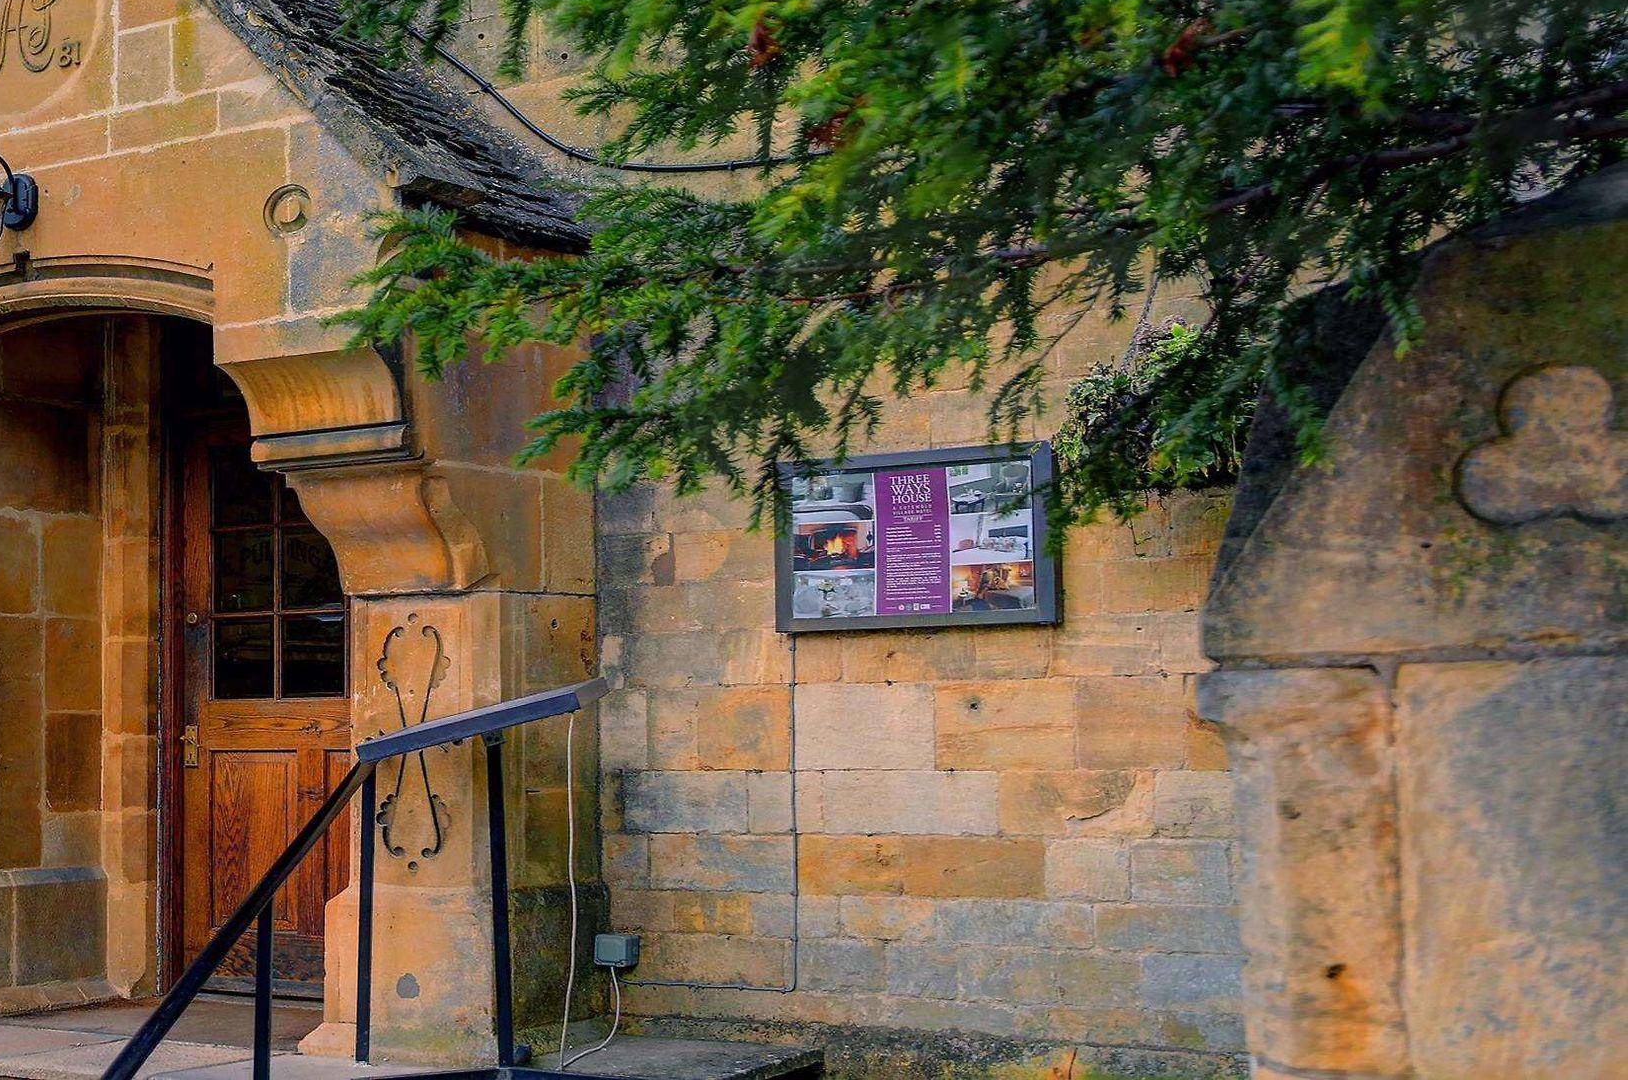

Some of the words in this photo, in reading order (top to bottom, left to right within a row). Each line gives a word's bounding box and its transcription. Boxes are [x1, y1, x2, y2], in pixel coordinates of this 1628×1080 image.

[889, 474, 931, 485] THREE
[890, 482, 931, 495] WAYS
[892, 493, 932, 504] HOUSE
